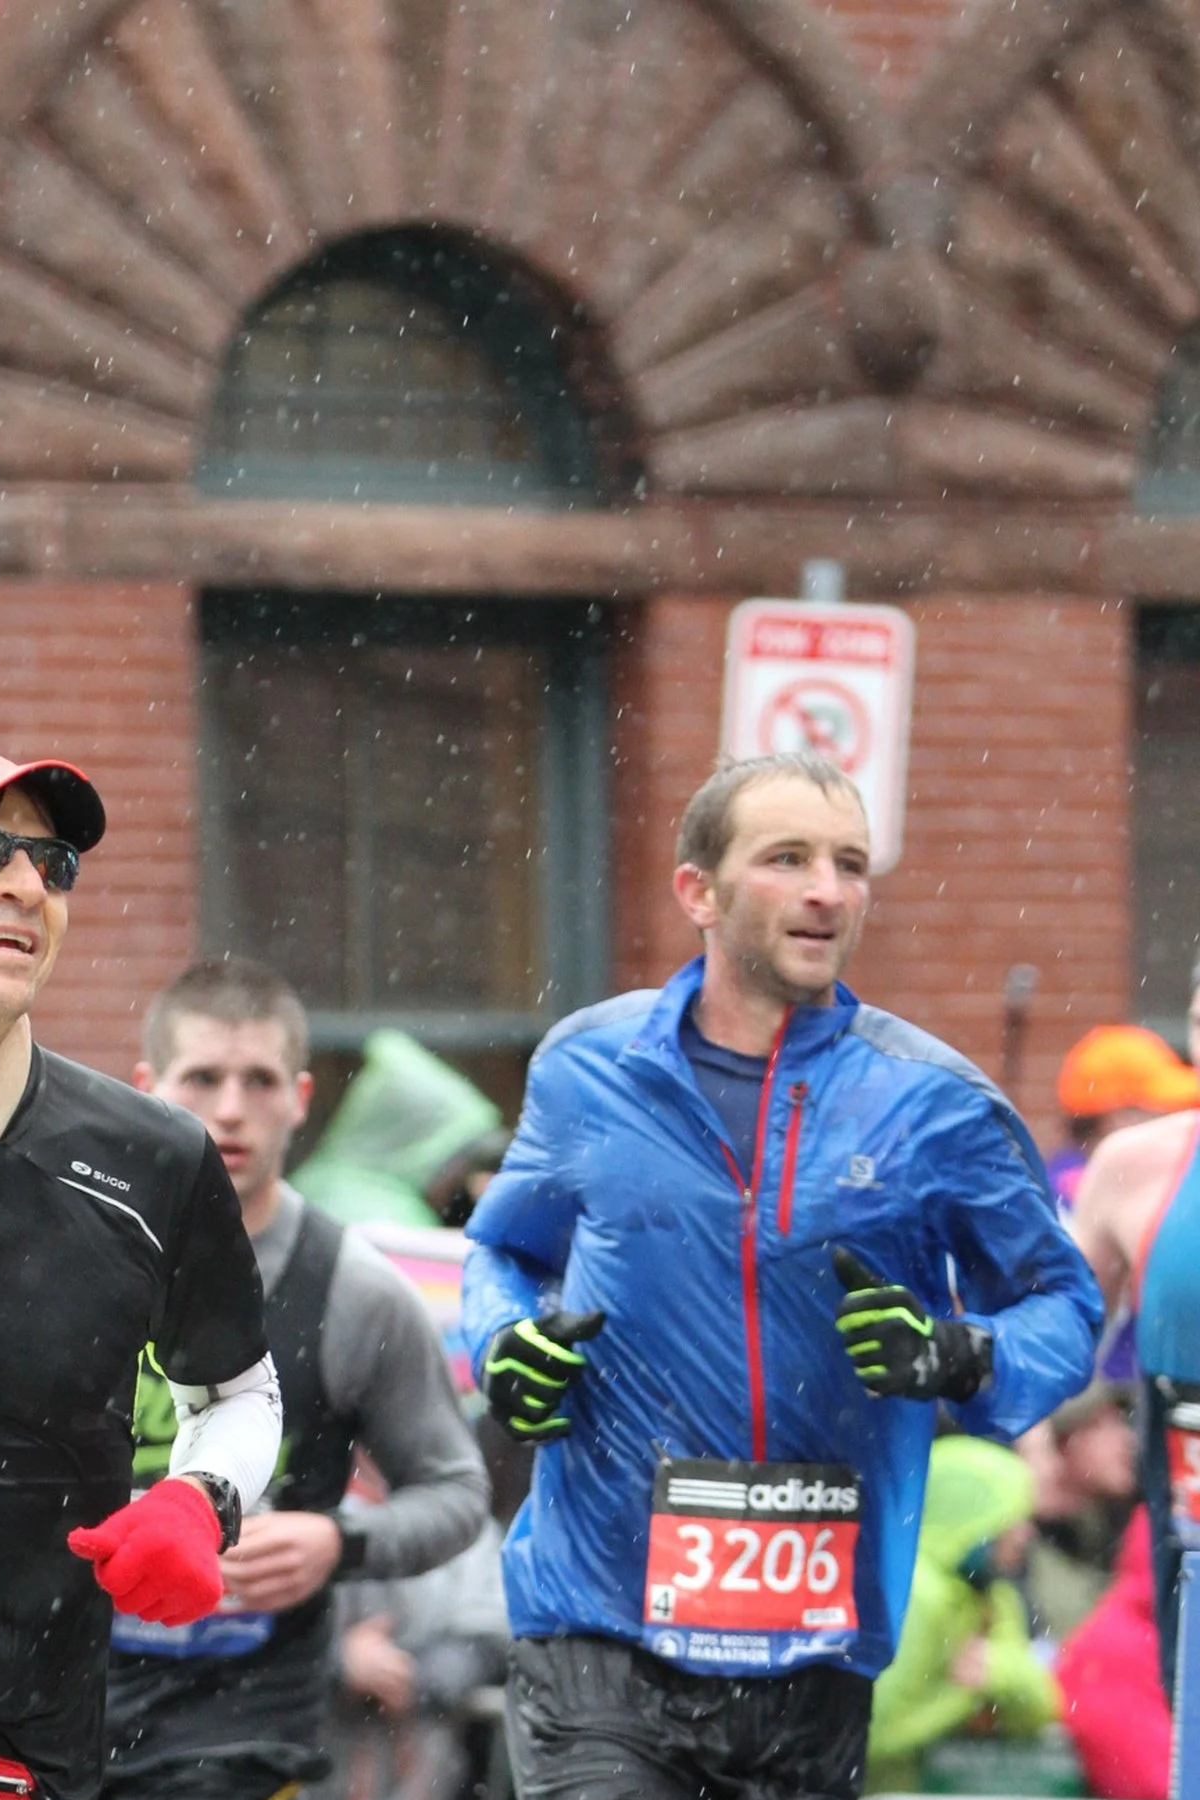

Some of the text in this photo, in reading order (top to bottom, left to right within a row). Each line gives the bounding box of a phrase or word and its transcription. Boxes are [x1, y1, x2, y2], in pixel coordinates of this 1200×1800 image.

[93, 1170, 131, 1192] SUGOI
[749, 1478, 859, 1512] adidas
[672, 1524, 840, 1594] 3206
[652, 1590, 672, 1618] 4
